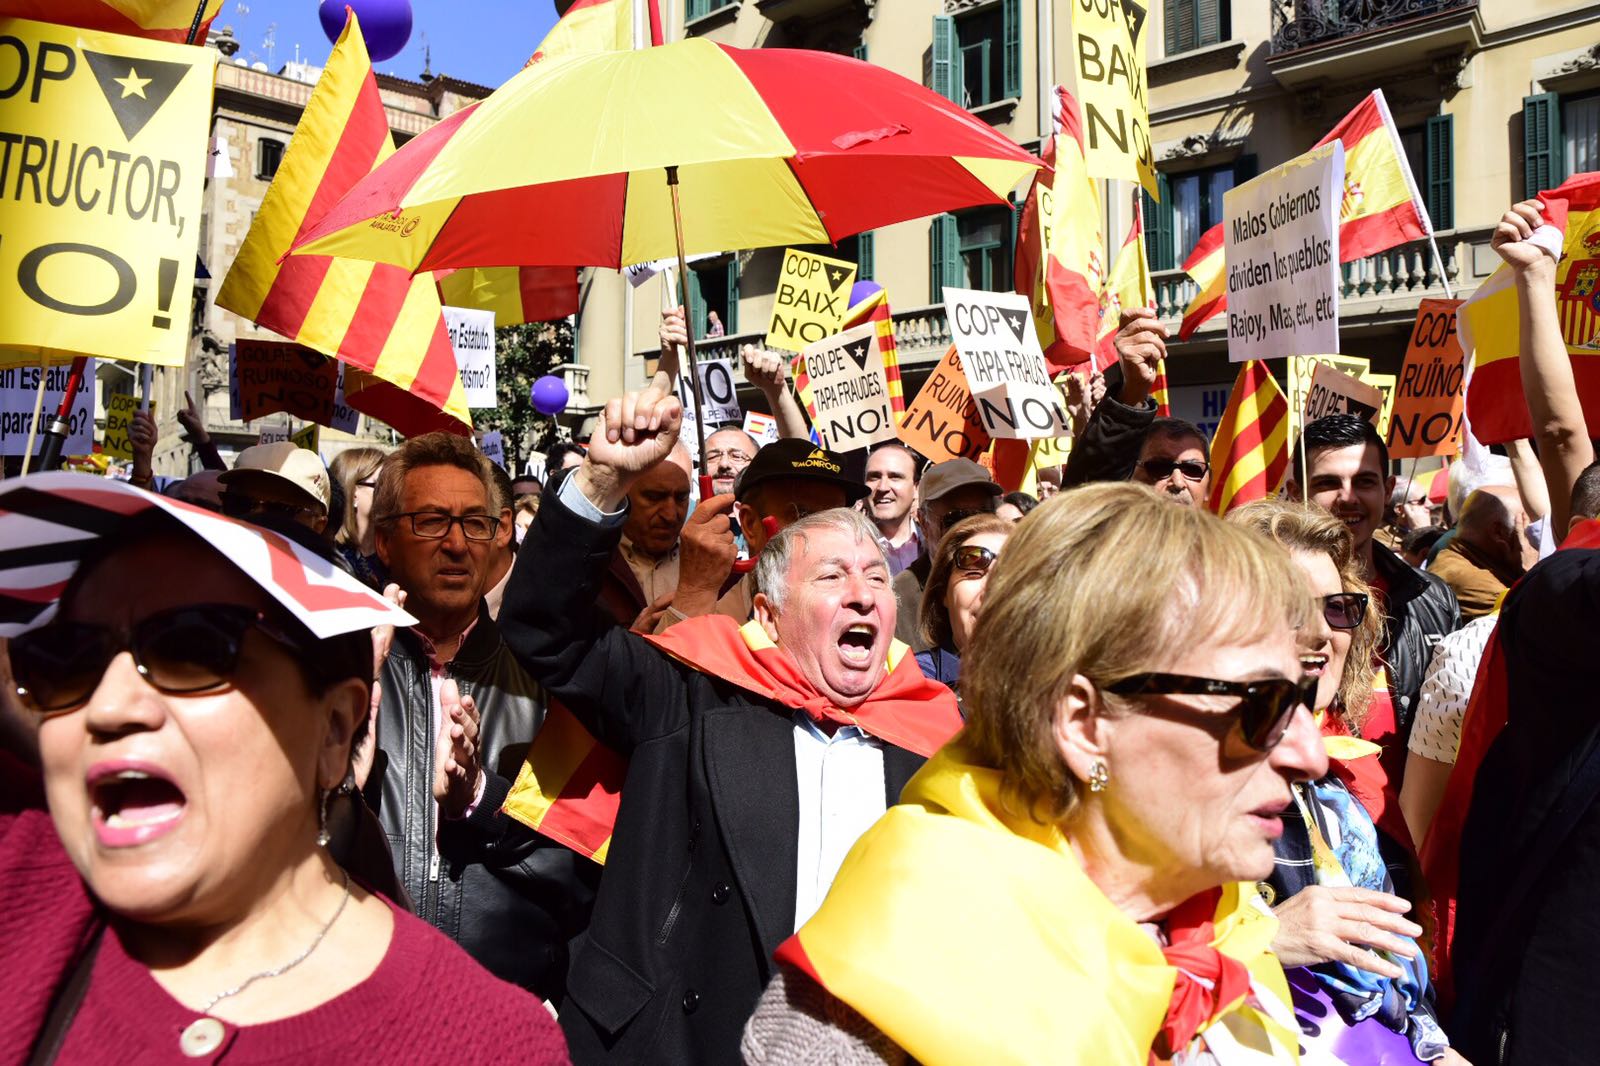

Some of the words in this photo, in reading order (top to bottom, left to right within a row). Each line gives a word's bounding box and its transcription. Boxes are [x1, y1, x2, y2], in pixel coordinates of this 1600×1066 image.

[1078, 32, 1147, 113] BAIX,
[1085, 102, 1154, 177] NO!
[1232, 210, 1267, 245] Malos
[1269, 185, 1321, 231] Gobiernos
[0, 234, 179, 330] O!
[786, 254, 822, 279] COP
[1229, 258, 1272, 293] dividen
[1273, 251, 1288, 281] los
[1288, 235, 1332, 285] pueblos:
[777, 283, 842, 322] BAIX,
[955, 302, 1000, 336] COP
[1230, 312, 1266, 344] Rajoy,
[1269, 302, 1297, 334] Mas,
[1296, 298, 1315, 331] etc.,
[1315, 291, 1335, 323] etc.
[458, 322, 490, 351] Estatuto.
[1414, 312, 1457, 348] COP
[807, 347, 846, 380] GOLPE
[964, 350, 1004, 382] TAPA
[1005, 350, 1052, 392] FRAUS,
[111, 396, 134, 412] COP
[813, 385, 839, 412] TAPA
[837, 371, 885, 407] FRAUDES,
[1307, 384, 1345, 419] GOLPE
[821, 405, 890, 451] ¡NO!
[979, 397, 1069, 430] NO!
[1387, 411, 1463, 446] NO!
[797, 459, 838, 473] MONROE
